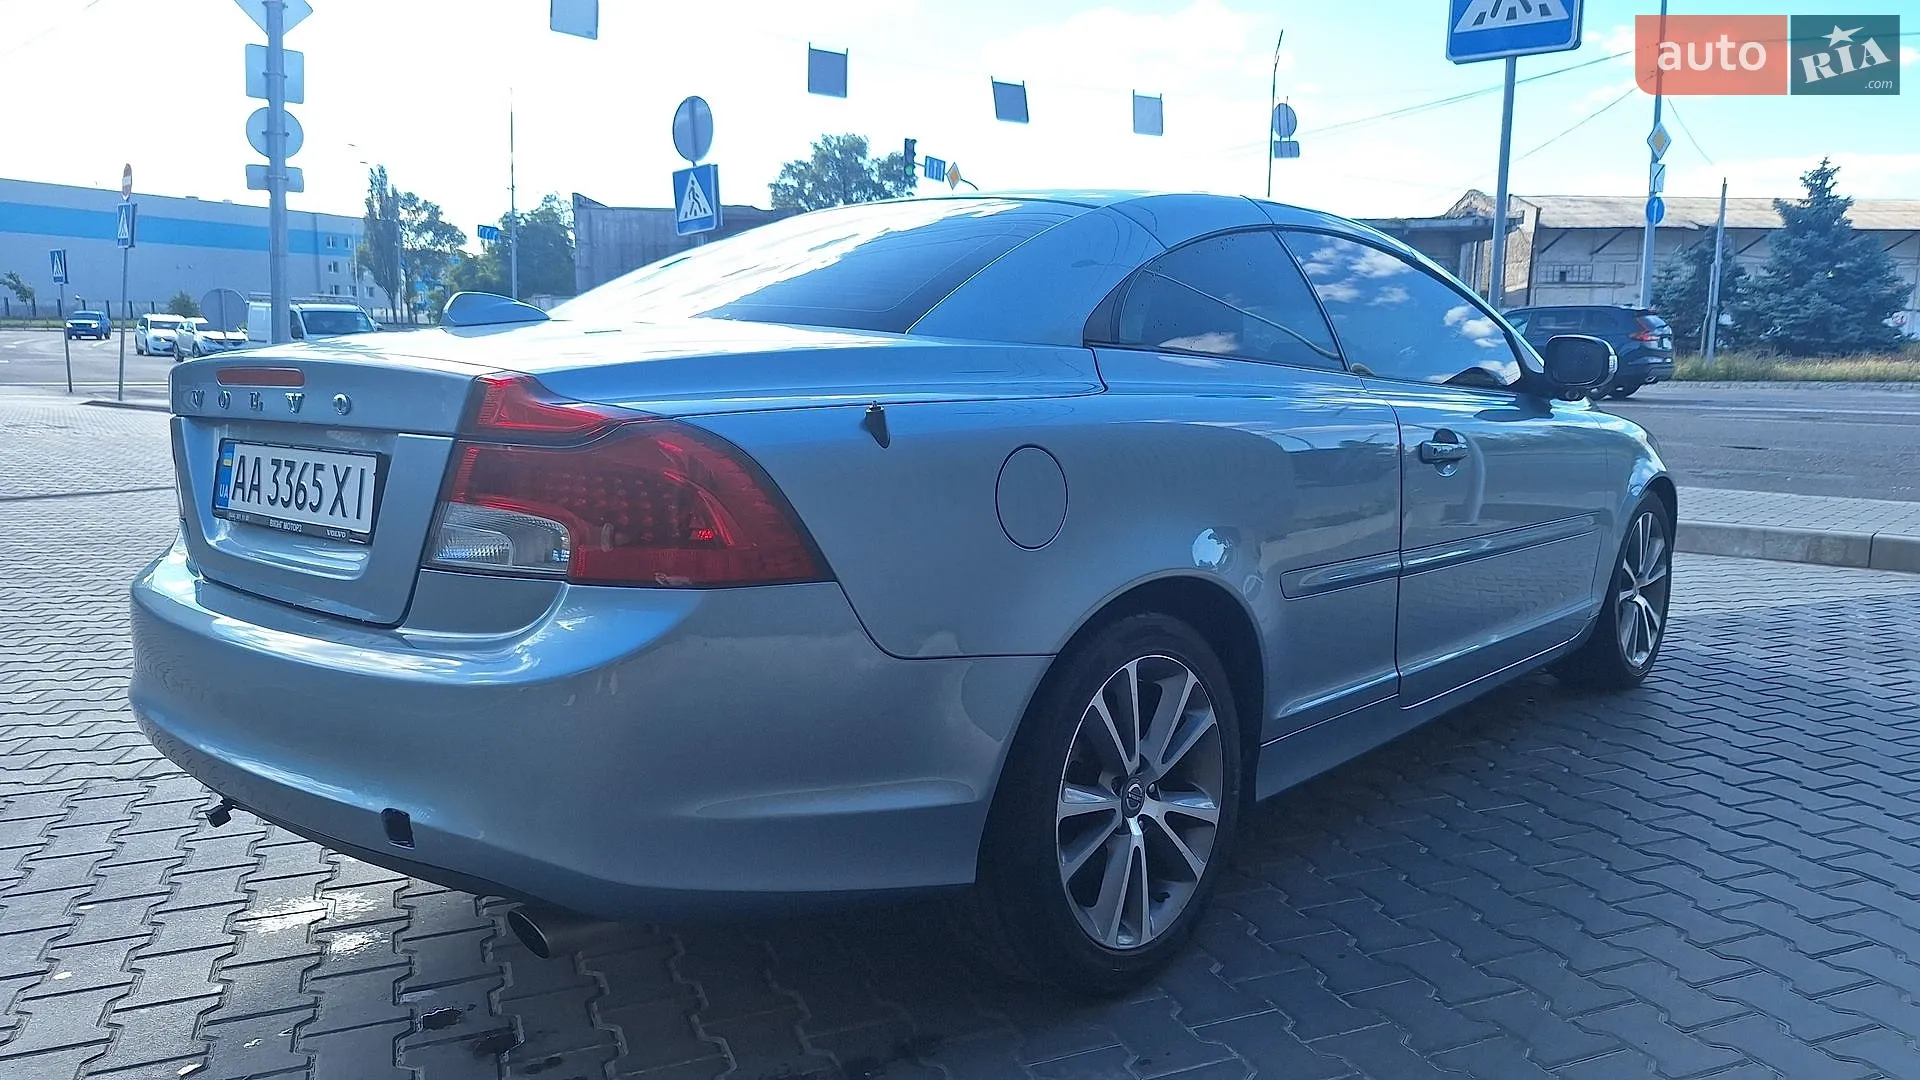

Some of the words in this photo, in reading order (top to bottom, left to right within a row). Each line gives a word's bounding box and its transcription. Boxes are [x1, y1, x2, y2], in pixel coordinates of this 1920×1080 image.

[191, 390, 352, 416] VOLVO
[219, 484, 229, 498] UA
[231, 455, 261, 505] AA
[267, 458, 325, 513] 3365
[328, 464, 365, 520] XI
[326, 528, 346, 538] VOLVO
